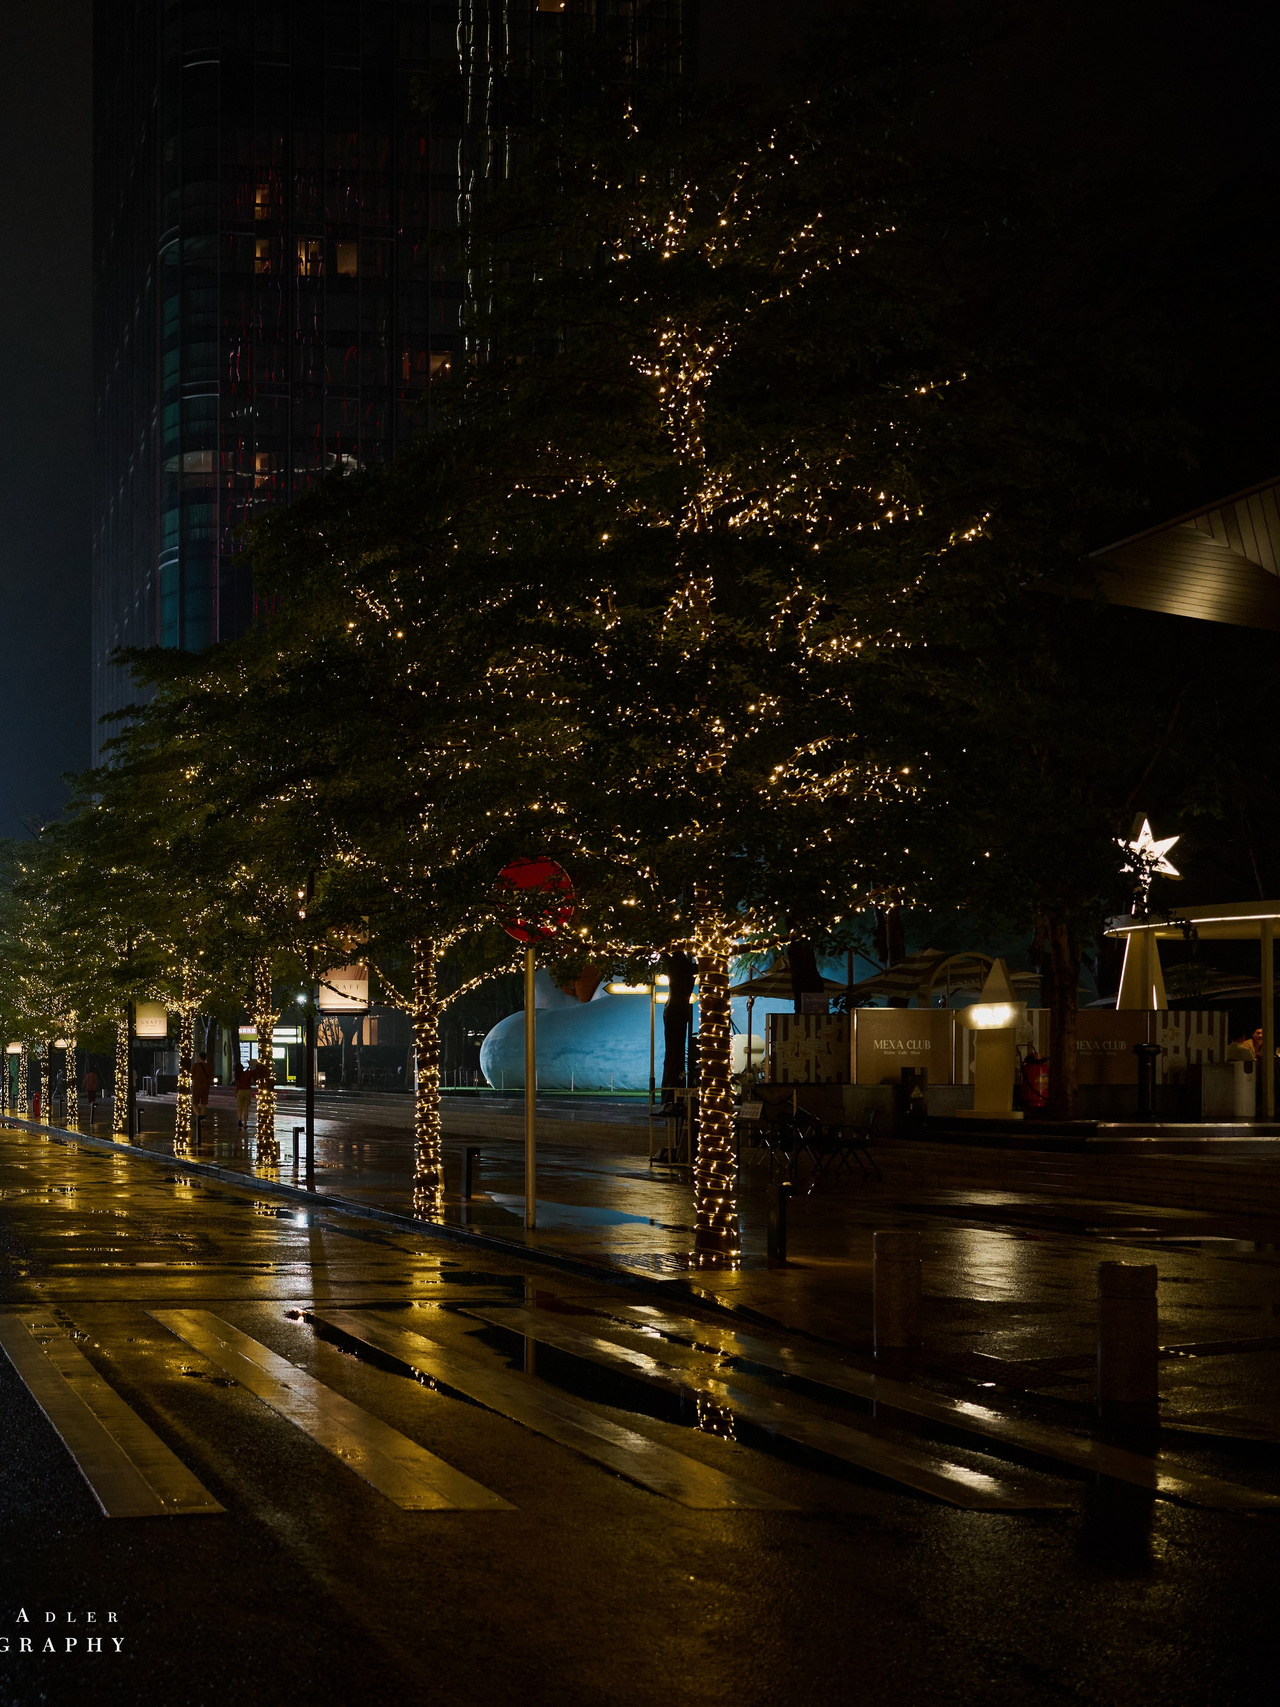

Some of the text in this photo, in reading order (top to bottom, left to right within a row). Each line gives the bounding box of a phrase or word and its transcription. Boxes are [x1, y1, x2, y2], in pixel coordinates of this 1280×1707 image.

[873, 1039, 931, 1050] MEXA CLUB
[1102, 1040, 1127, 1051] CLUB
